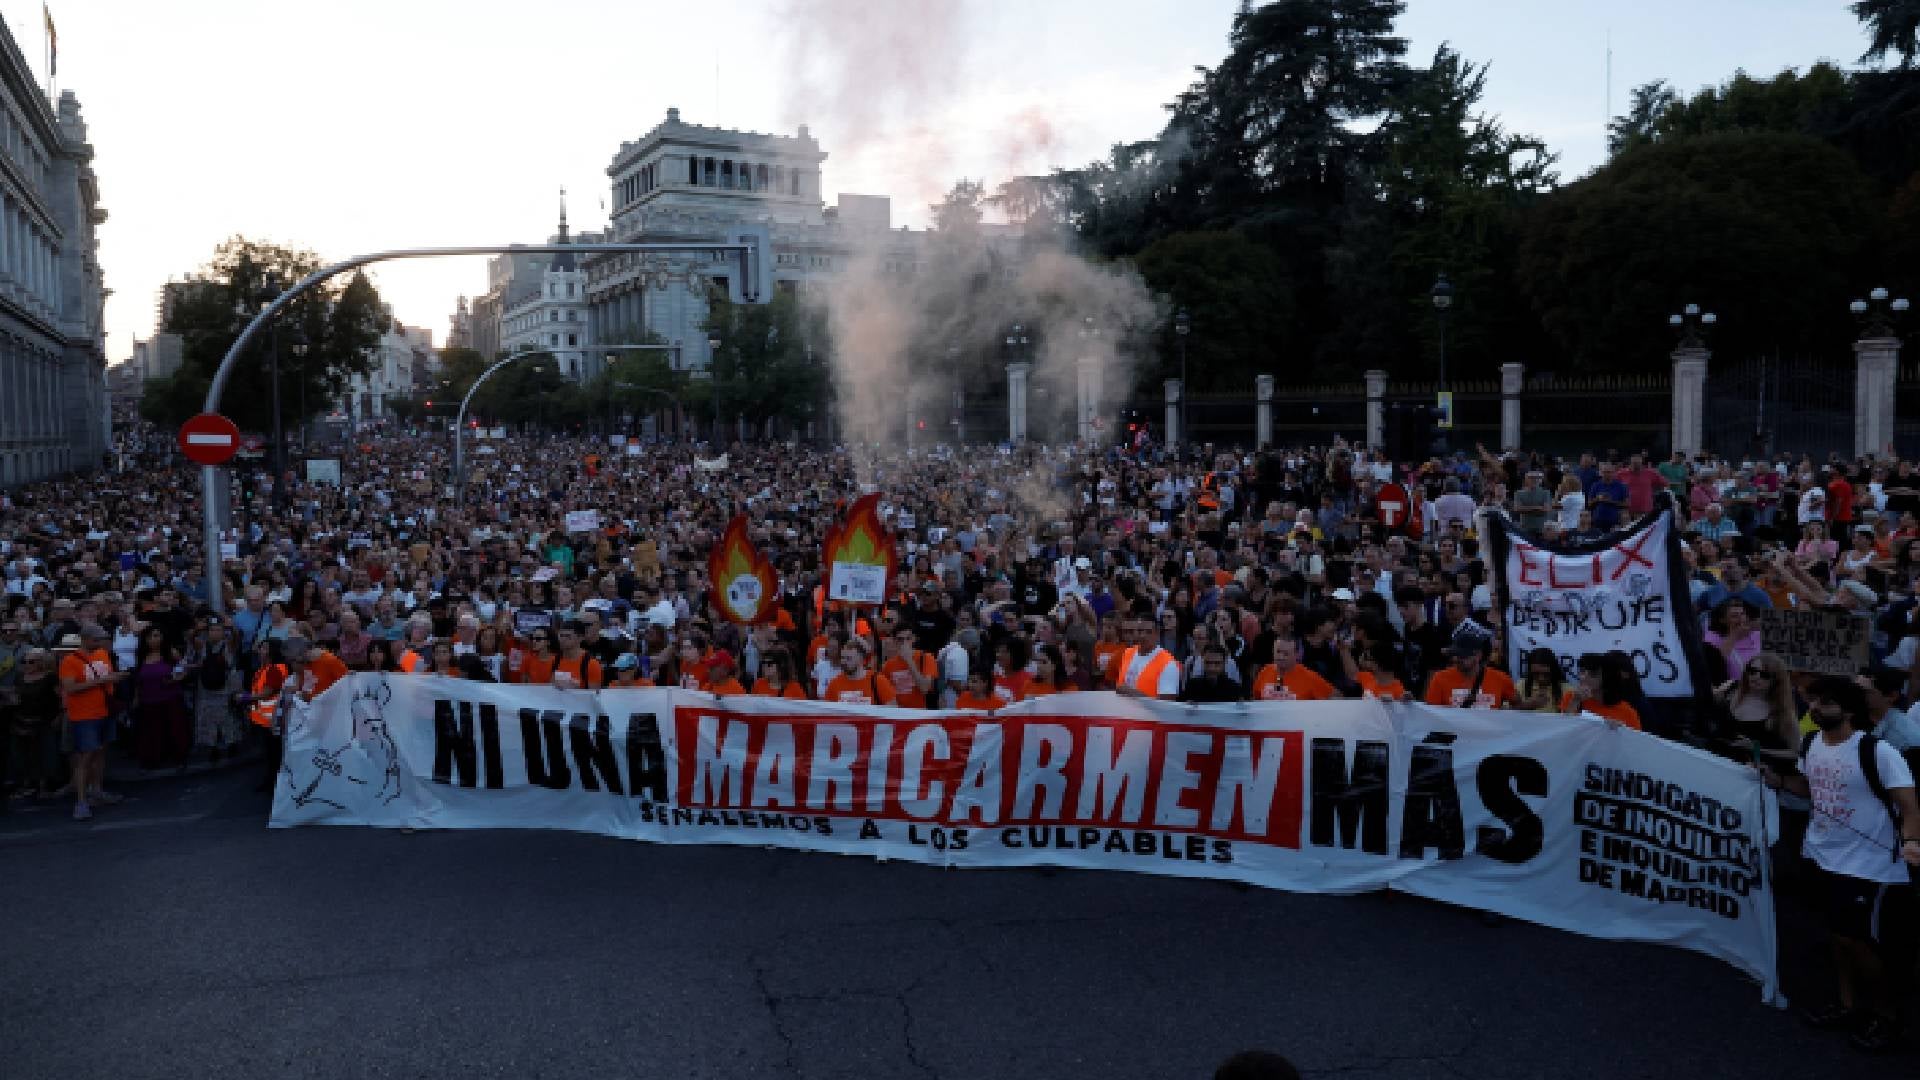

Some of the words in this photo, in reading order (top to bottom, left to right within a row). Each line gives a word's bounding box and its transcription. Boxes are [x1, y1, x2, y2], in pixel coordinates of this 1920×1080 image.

[1516, 525, 1657, 589] ELIX
[433, 700, 504, 789] NI
[520, 708, 668, 803] UNA
[692, 714, 1285, 837] MARICARMEN
[1309, 732, 1549, 863] MÁS
[1584, 762, 1742, 830] SINDICATO
[859, 818, 882, 840] A
[908, 824, 968, 850] LOS
[1001, 825, 1233, 863] CULPABLES
[1581, 799, 1618, 828] DE
[1581, 829, 1597, 856] E
[1579, 857, 1615, 888] DE
[1620, 868, 1739, 920] MADRID
